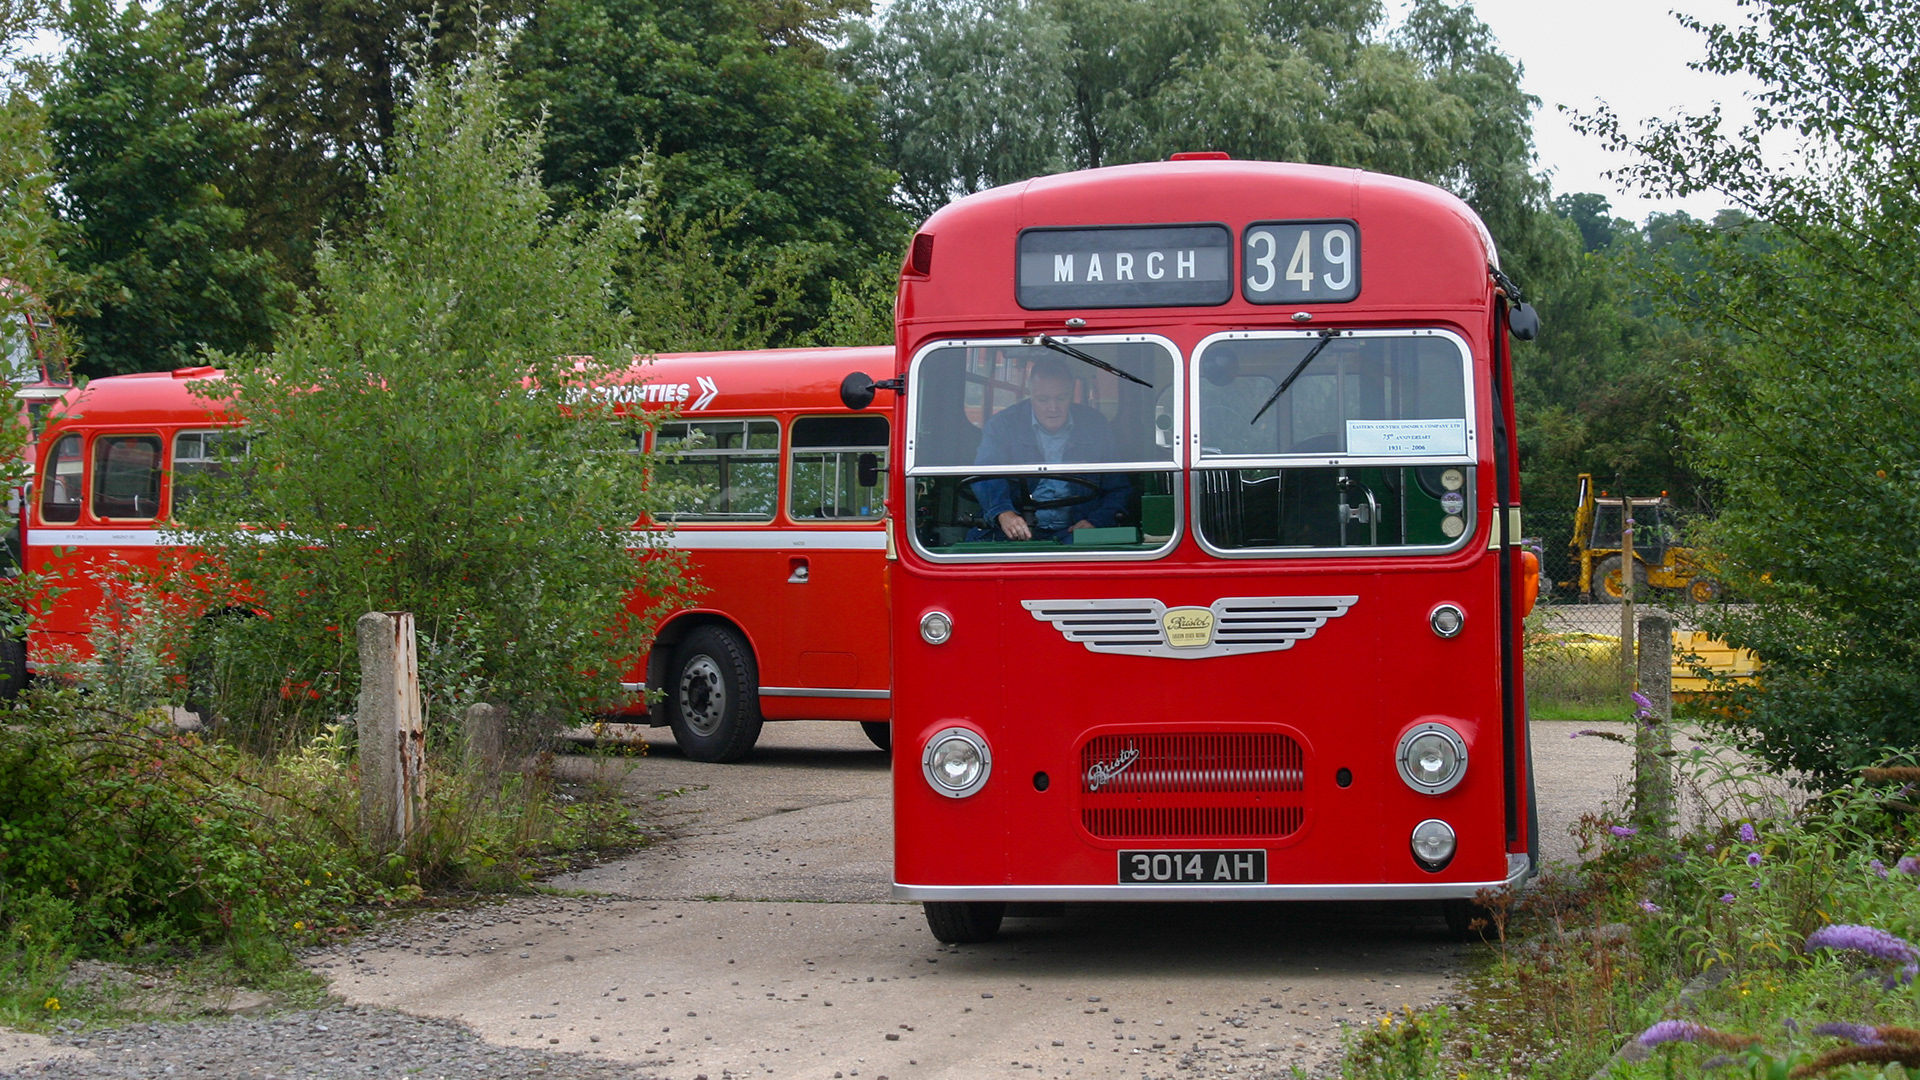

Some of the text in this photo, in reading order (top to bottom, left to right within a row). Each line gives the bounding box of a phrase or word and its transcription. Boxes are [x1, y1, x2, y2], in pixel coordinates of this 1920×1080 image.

[1053, 250, 1196, 282] MARCH
[1246, 228, 1352, 293] 349
[1167, 615, 1210, 630] Bristol
[1088, 739, 1139, 791] Bristol
[1131, 853, 1254, 881] 3014 AH
